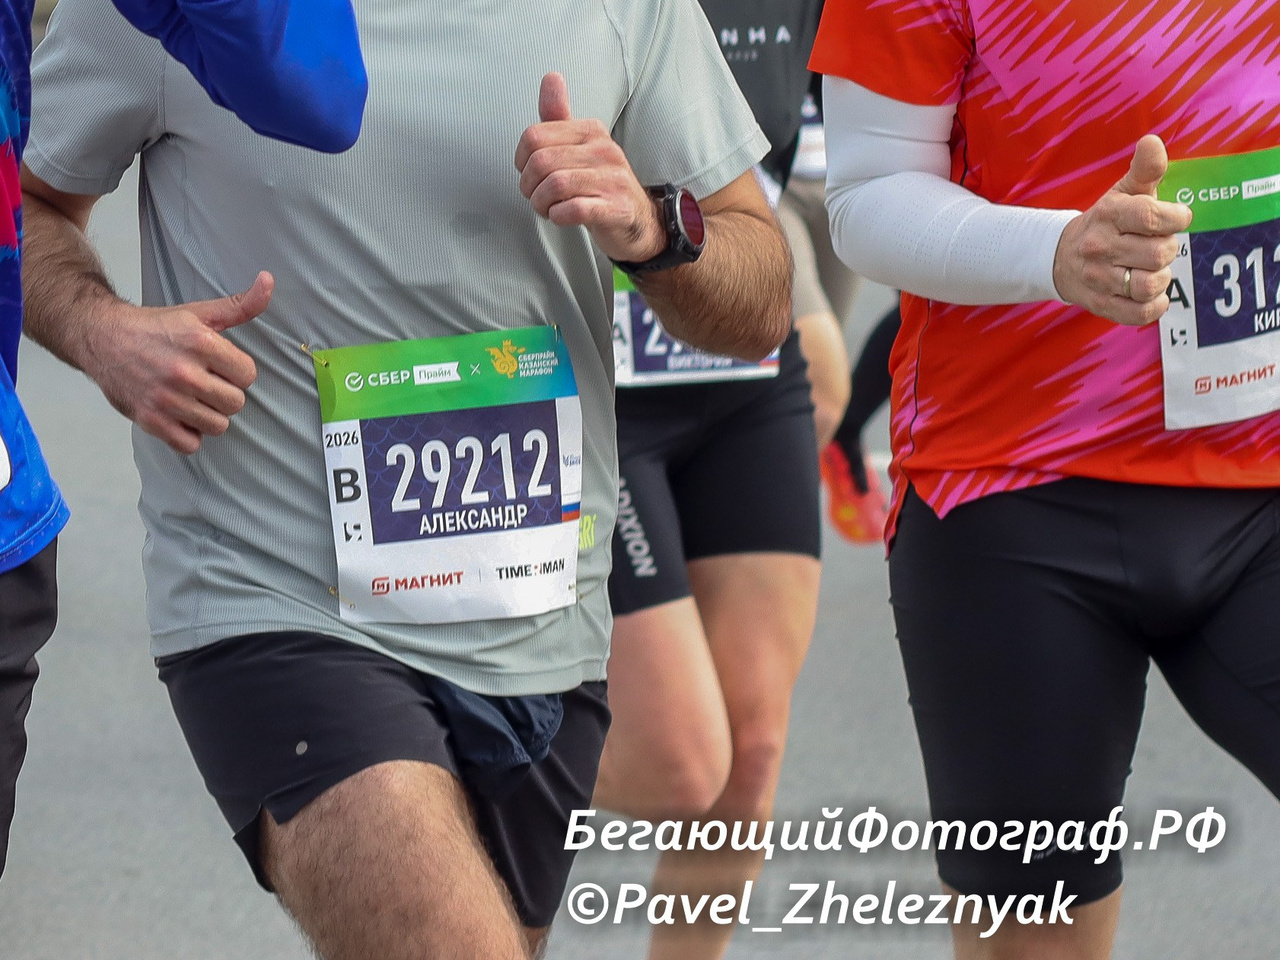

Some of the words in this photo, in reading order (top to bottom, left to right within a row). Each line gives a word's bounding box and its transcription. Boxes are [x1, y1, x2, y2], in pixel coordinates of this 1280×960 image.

[1198, 186, 1240, 202] СБЕР
[367, 369, 411, 387] СБЕР
[419, 369, 452, 380] Прайм
[1216, 363, 1276, 389] МАГНИТ
[325, 430, 359, 448] 2026
[385, 428, 553, 513] 29212
[333, 467, 362, 505] B
[419, 504, 528, 536] АЛЕКСАНДР
[395, 571, 464, 591] МАГНИТ
